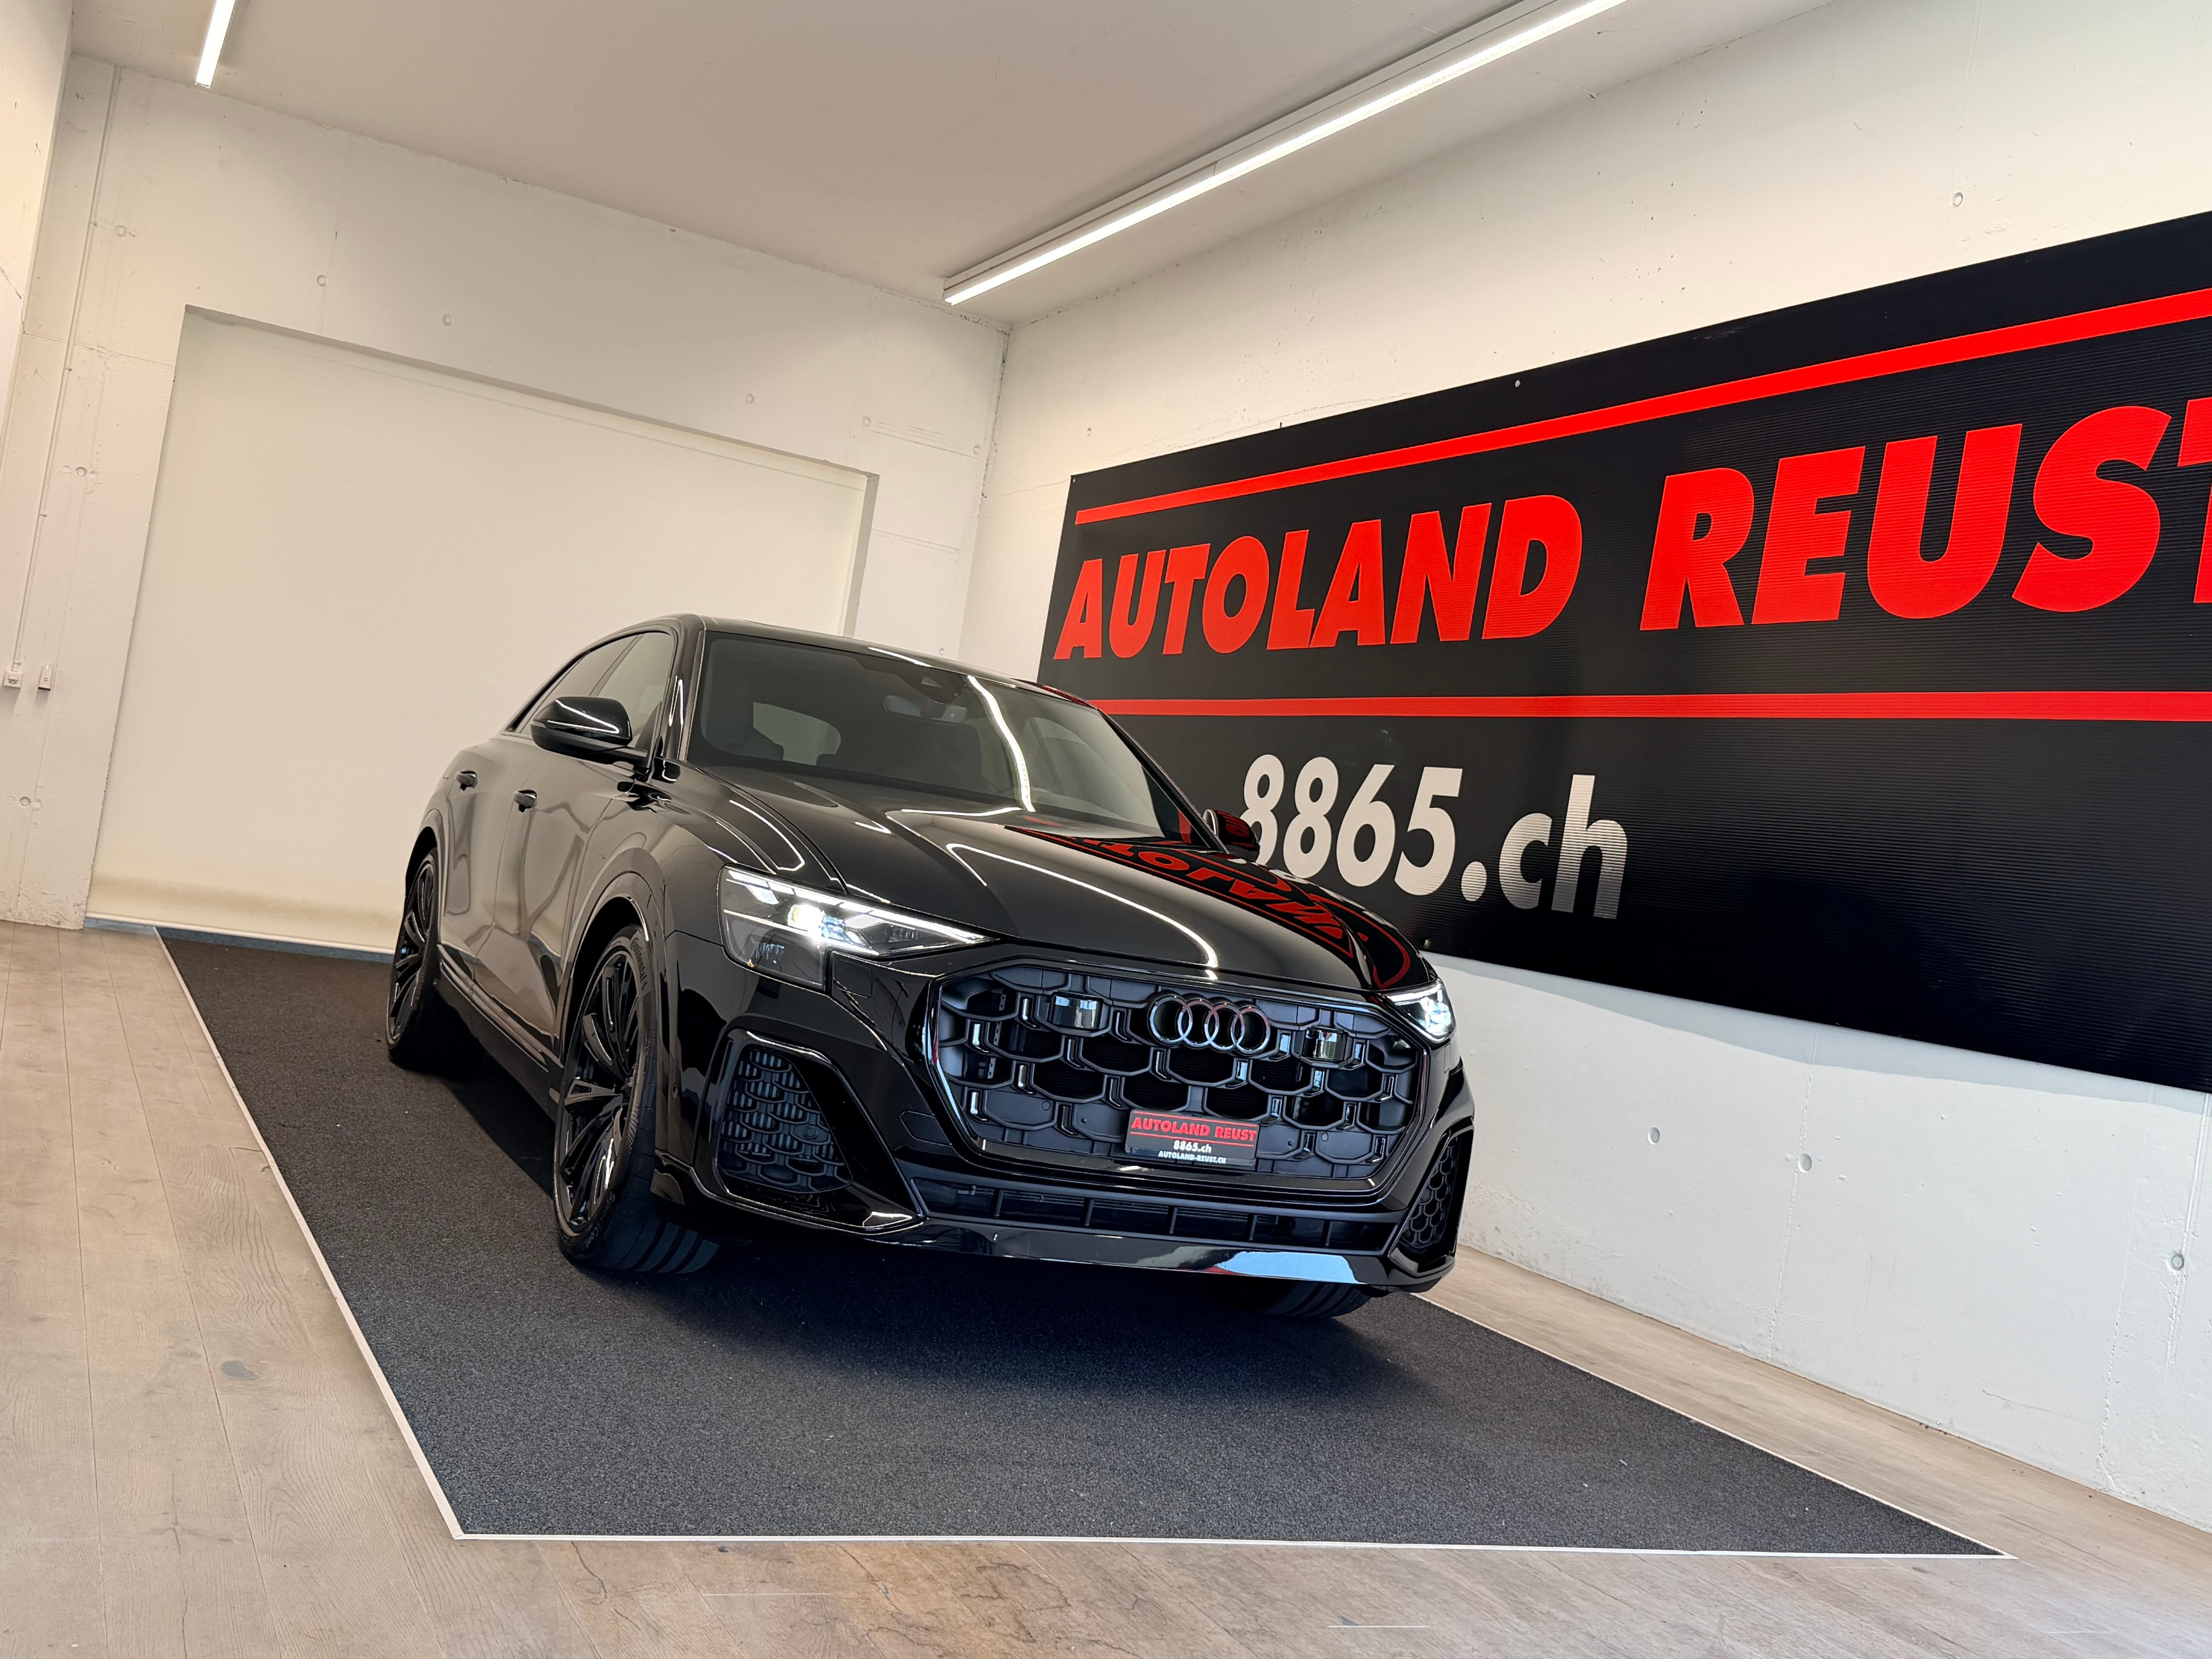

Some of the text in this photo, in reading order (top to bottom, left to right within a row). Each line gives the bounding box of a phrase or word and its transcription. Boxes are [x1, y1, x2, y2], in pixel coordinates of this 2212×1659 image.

[1054, 397, 2212, 660] AUTOLAND REUS
[1240, 754, 1628, 919] 8865.ch
[630, 938, 647, 982] Continental
[1131, 1117, 1257, 1142] AUTOLAND REUST
[1158, 1151, 1227, 1164] AUTOLAND-REUST.CH
[1173, 1140, 1212, 1154] 8865.ch
